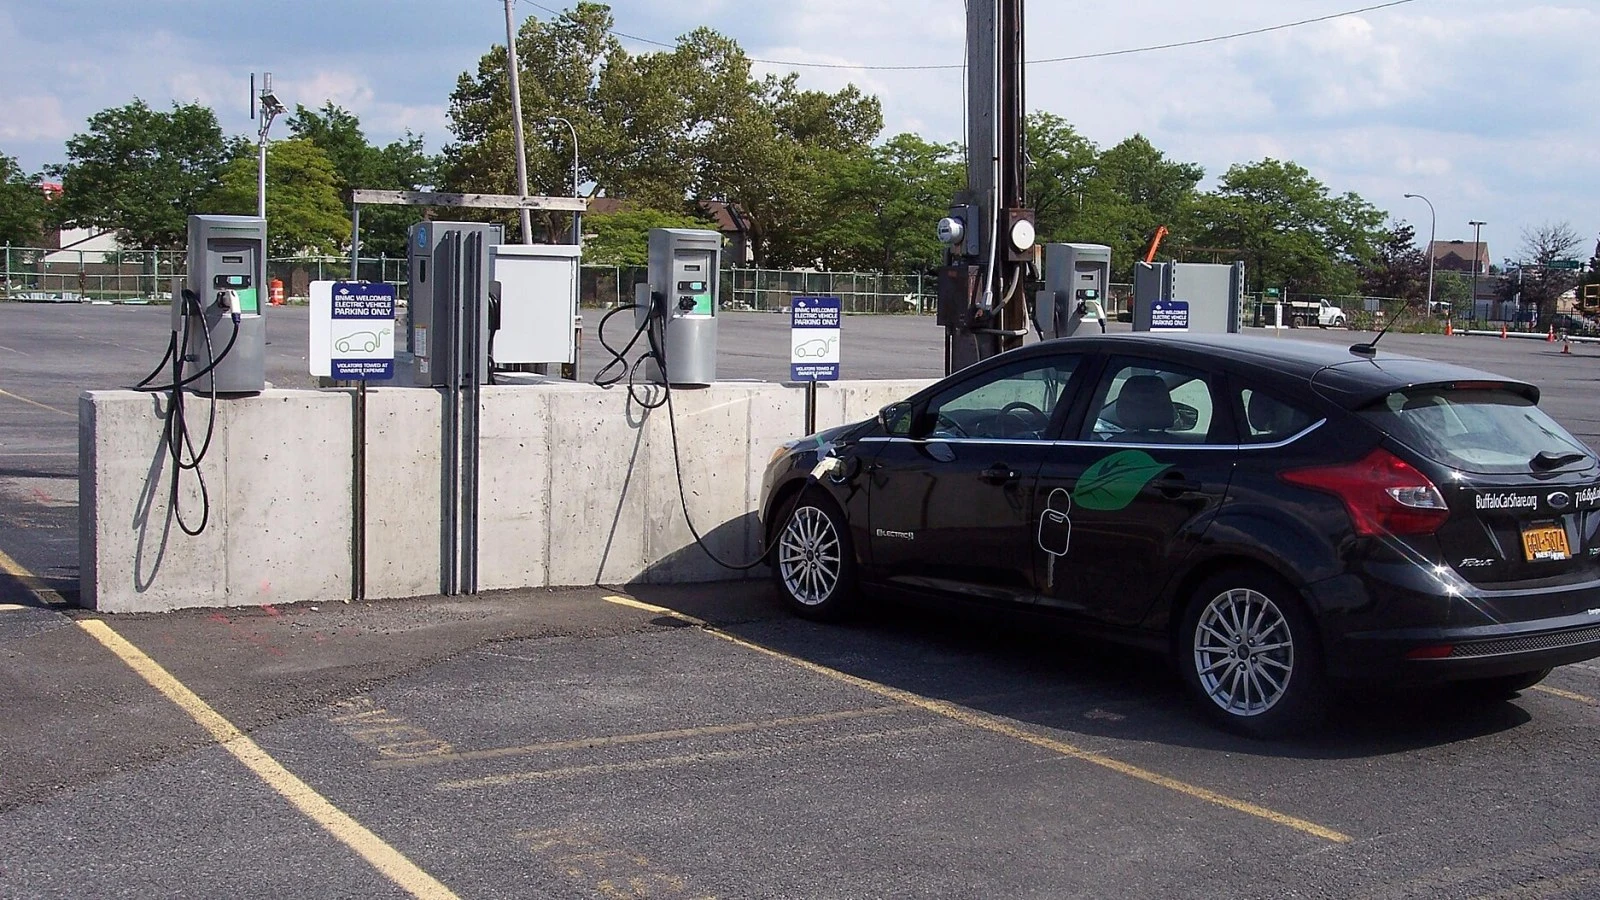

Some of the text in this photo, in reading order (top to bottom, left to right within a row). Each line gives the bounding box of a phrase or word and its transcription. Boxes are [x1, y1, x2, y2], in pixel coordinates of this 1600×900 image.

[335, 308, 391, 316] PARKING ONLY
[1475, 492, 1537, 510] BuffaloCarShare.org
